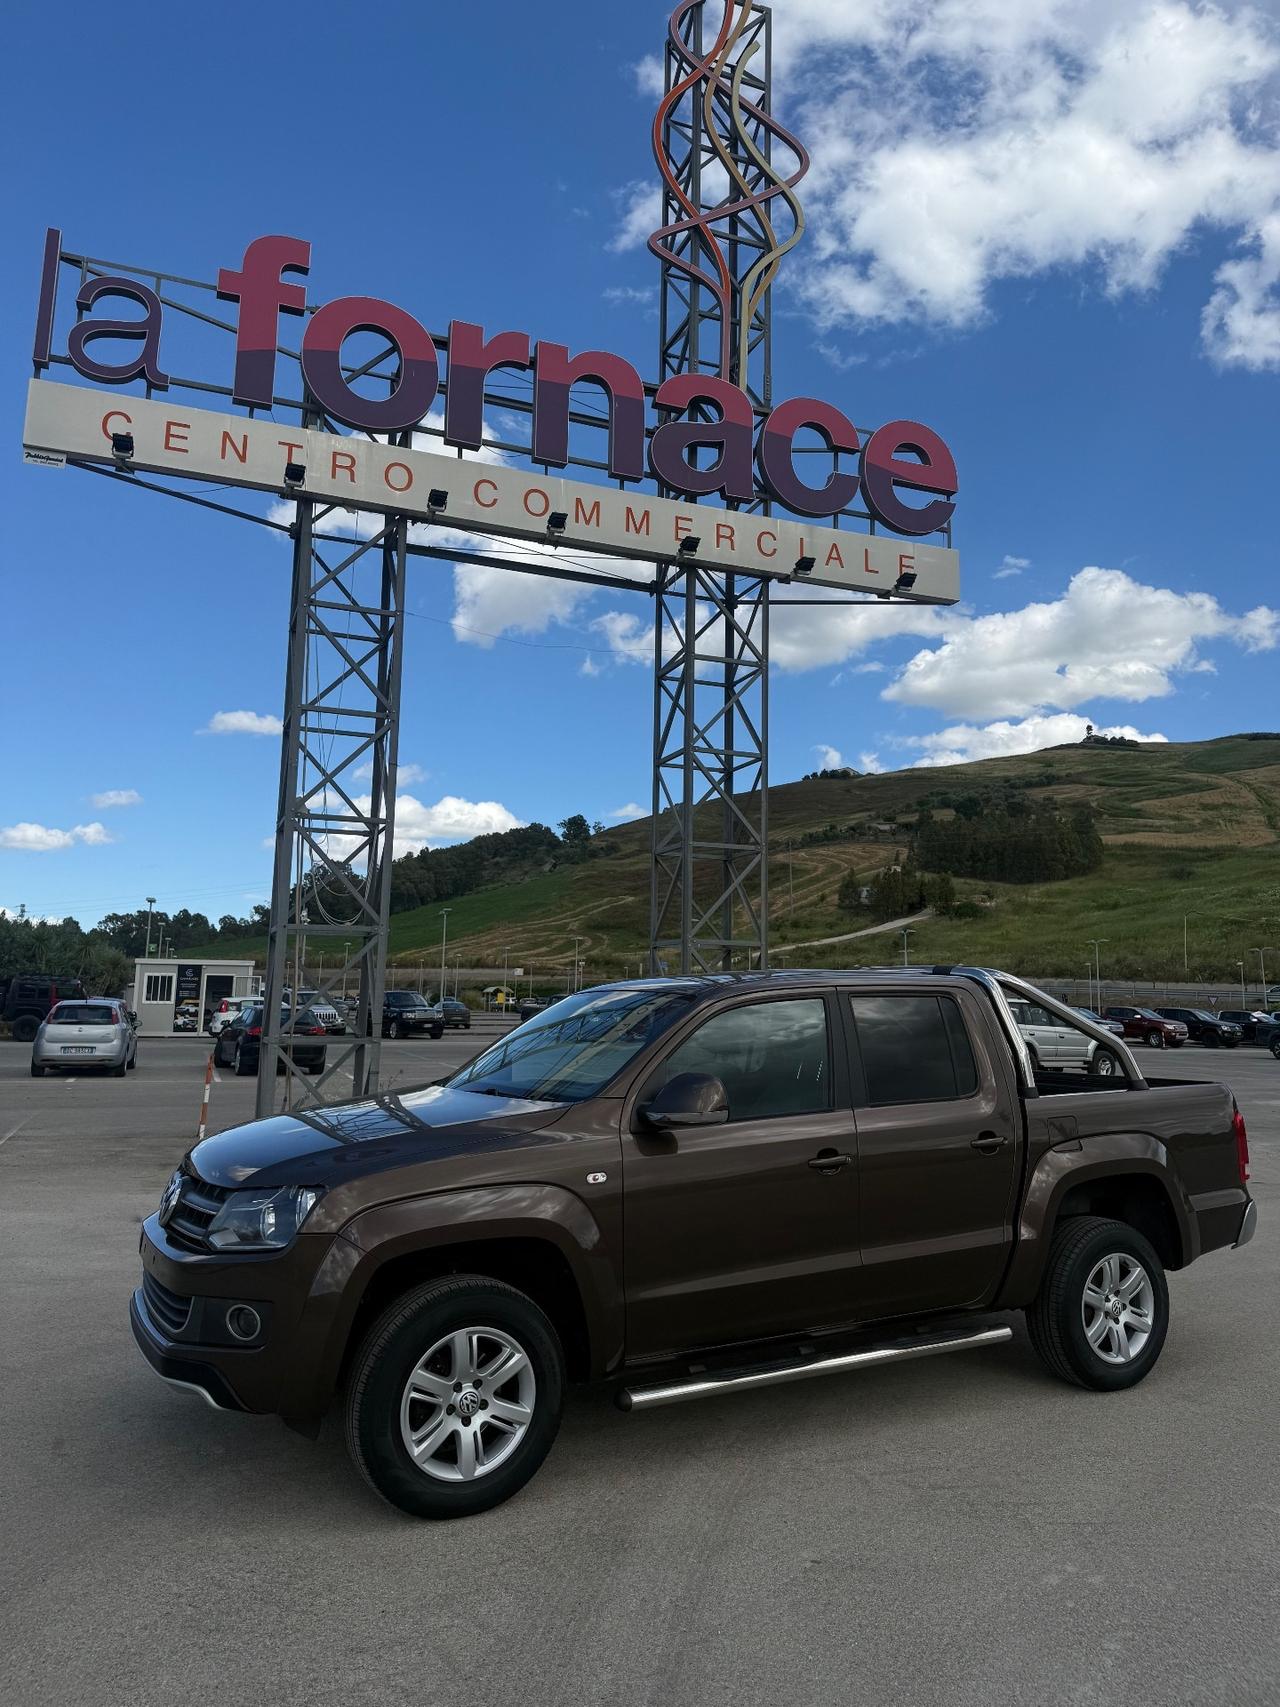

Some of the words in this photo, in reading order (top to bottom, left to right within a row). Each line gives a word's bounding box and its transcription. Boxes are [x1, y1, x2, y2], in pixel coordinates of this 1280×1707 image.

[32, 227, 170, 392] la
[217, 234, 958, 536] fornace
[101, 410, 414, 492] CENTRO
[472, 478, 915, 577] COMMERCIALE
